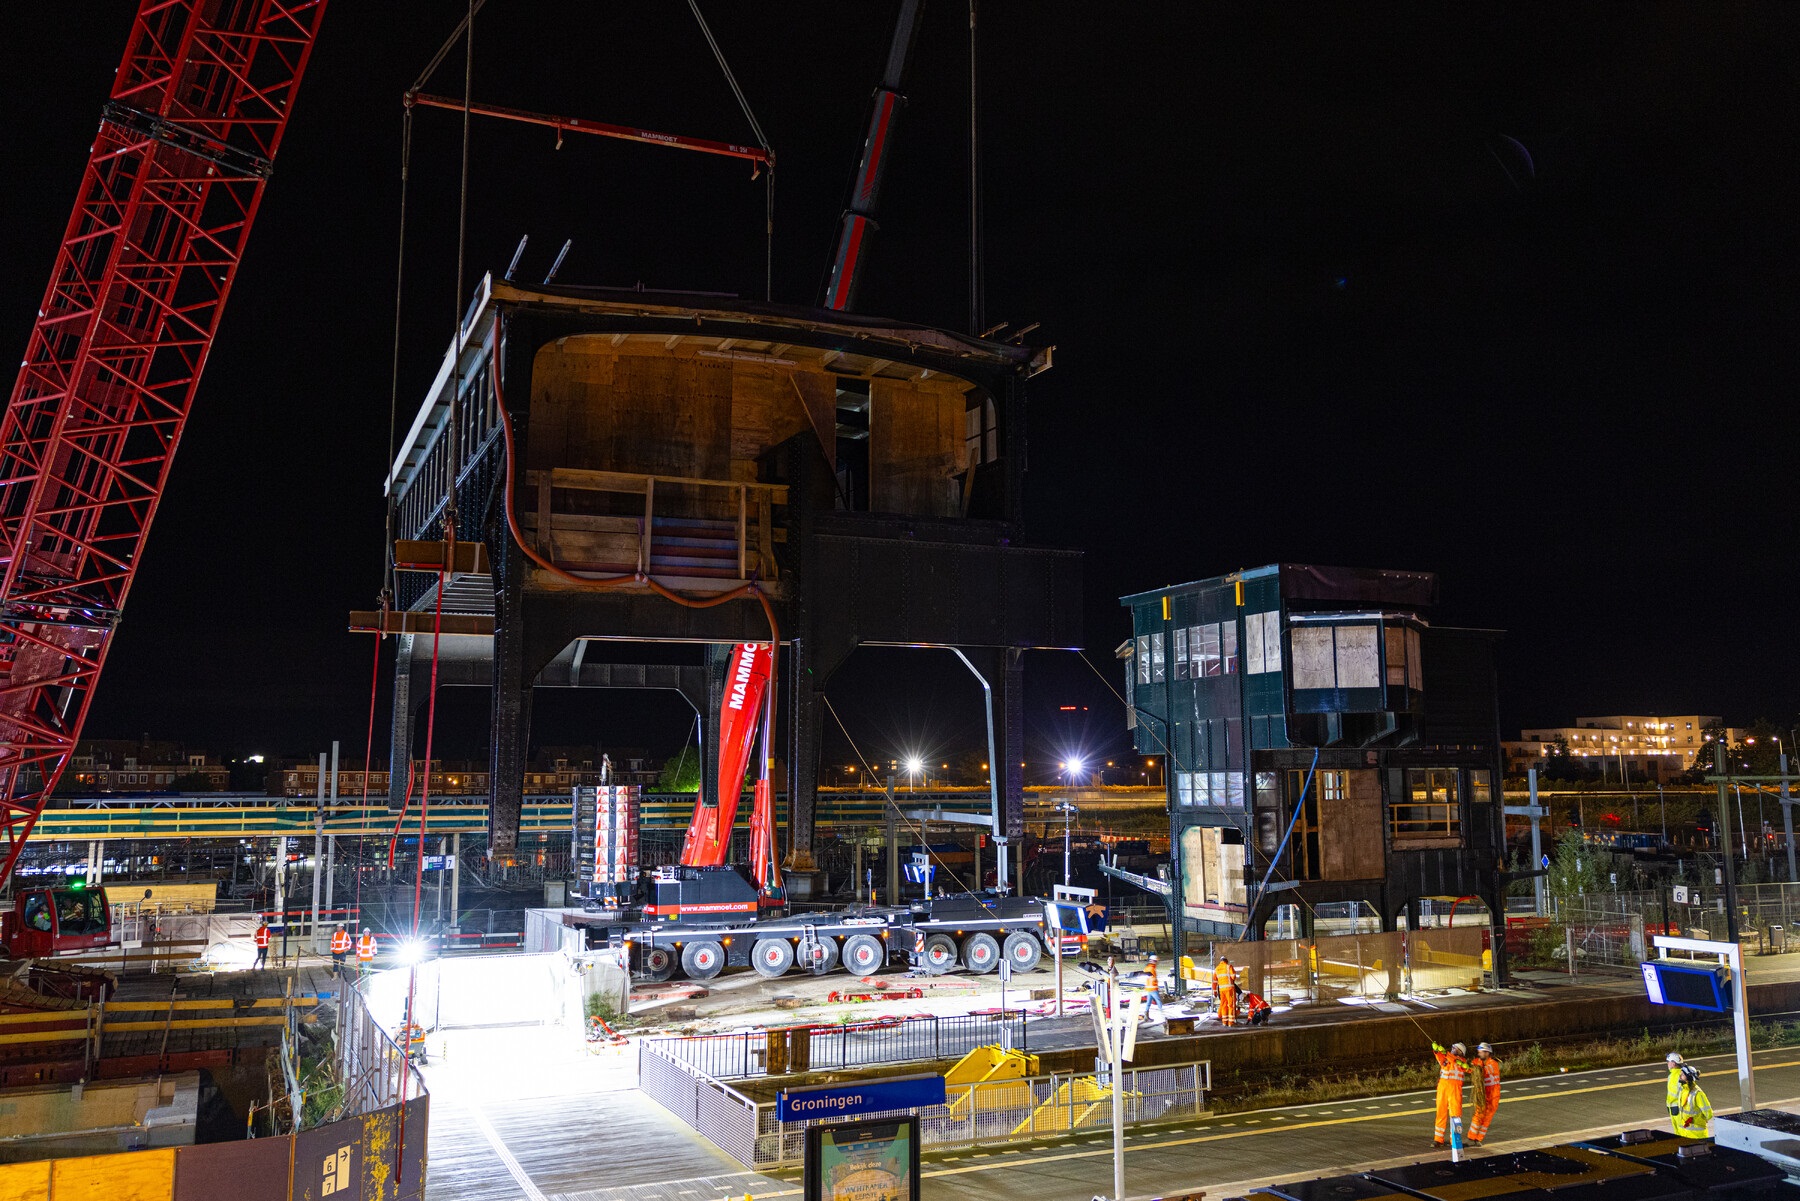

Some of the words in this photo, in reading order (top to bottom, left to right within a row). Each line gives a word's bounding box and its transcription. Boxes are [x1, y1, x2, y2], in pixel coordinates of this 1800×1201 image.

[641, 131, 677, 143] MAMMOET
[447, 859, 453, 868] 7
[680, 904, 748, 913] www.mammoet.com
[791, 1094, 863, 1112] Groningen
[326, 1161, 333, 1172] 6
[326, 1182, 332, 1194] 7
